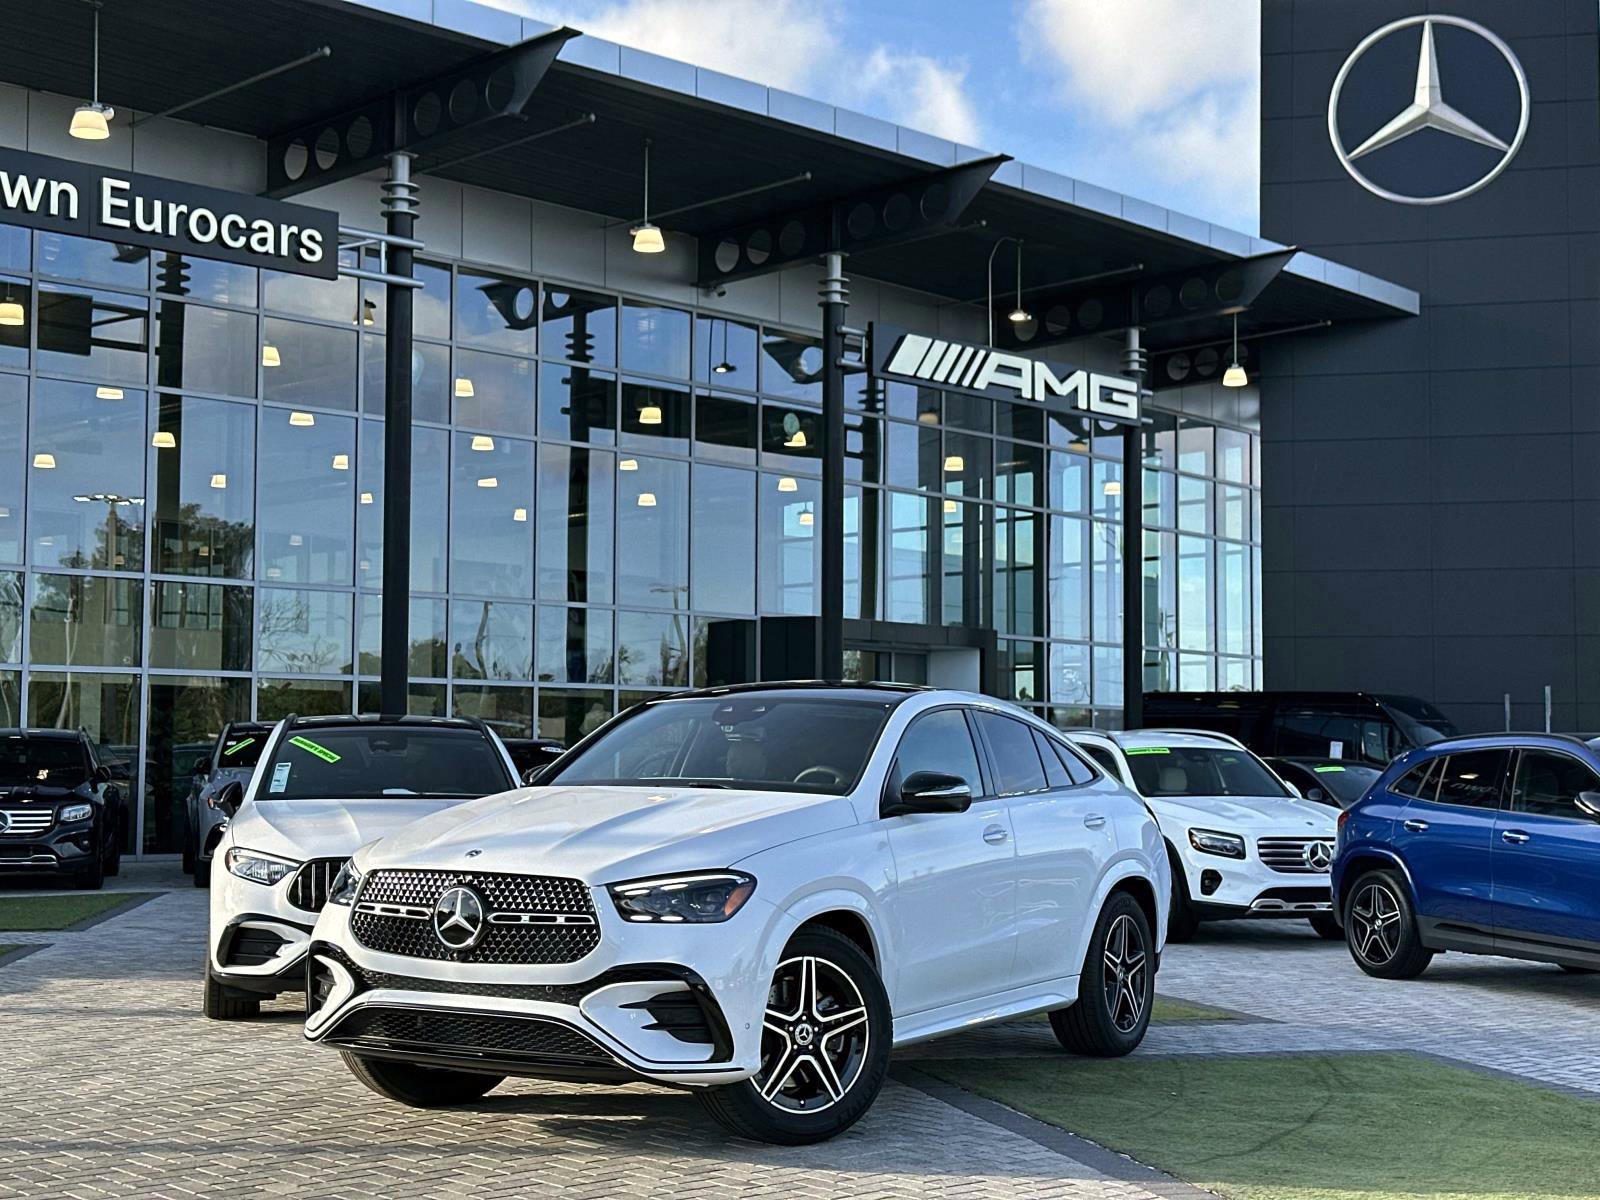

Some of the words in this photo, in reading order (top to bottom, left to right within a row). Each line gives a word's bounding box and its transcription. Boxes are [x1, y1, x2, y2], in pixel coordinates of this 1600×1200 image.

[0, 170, 78, 219] wn
[102, 177, 323, 262] Eurocars
[973, 351, 1137, 419] AMG
